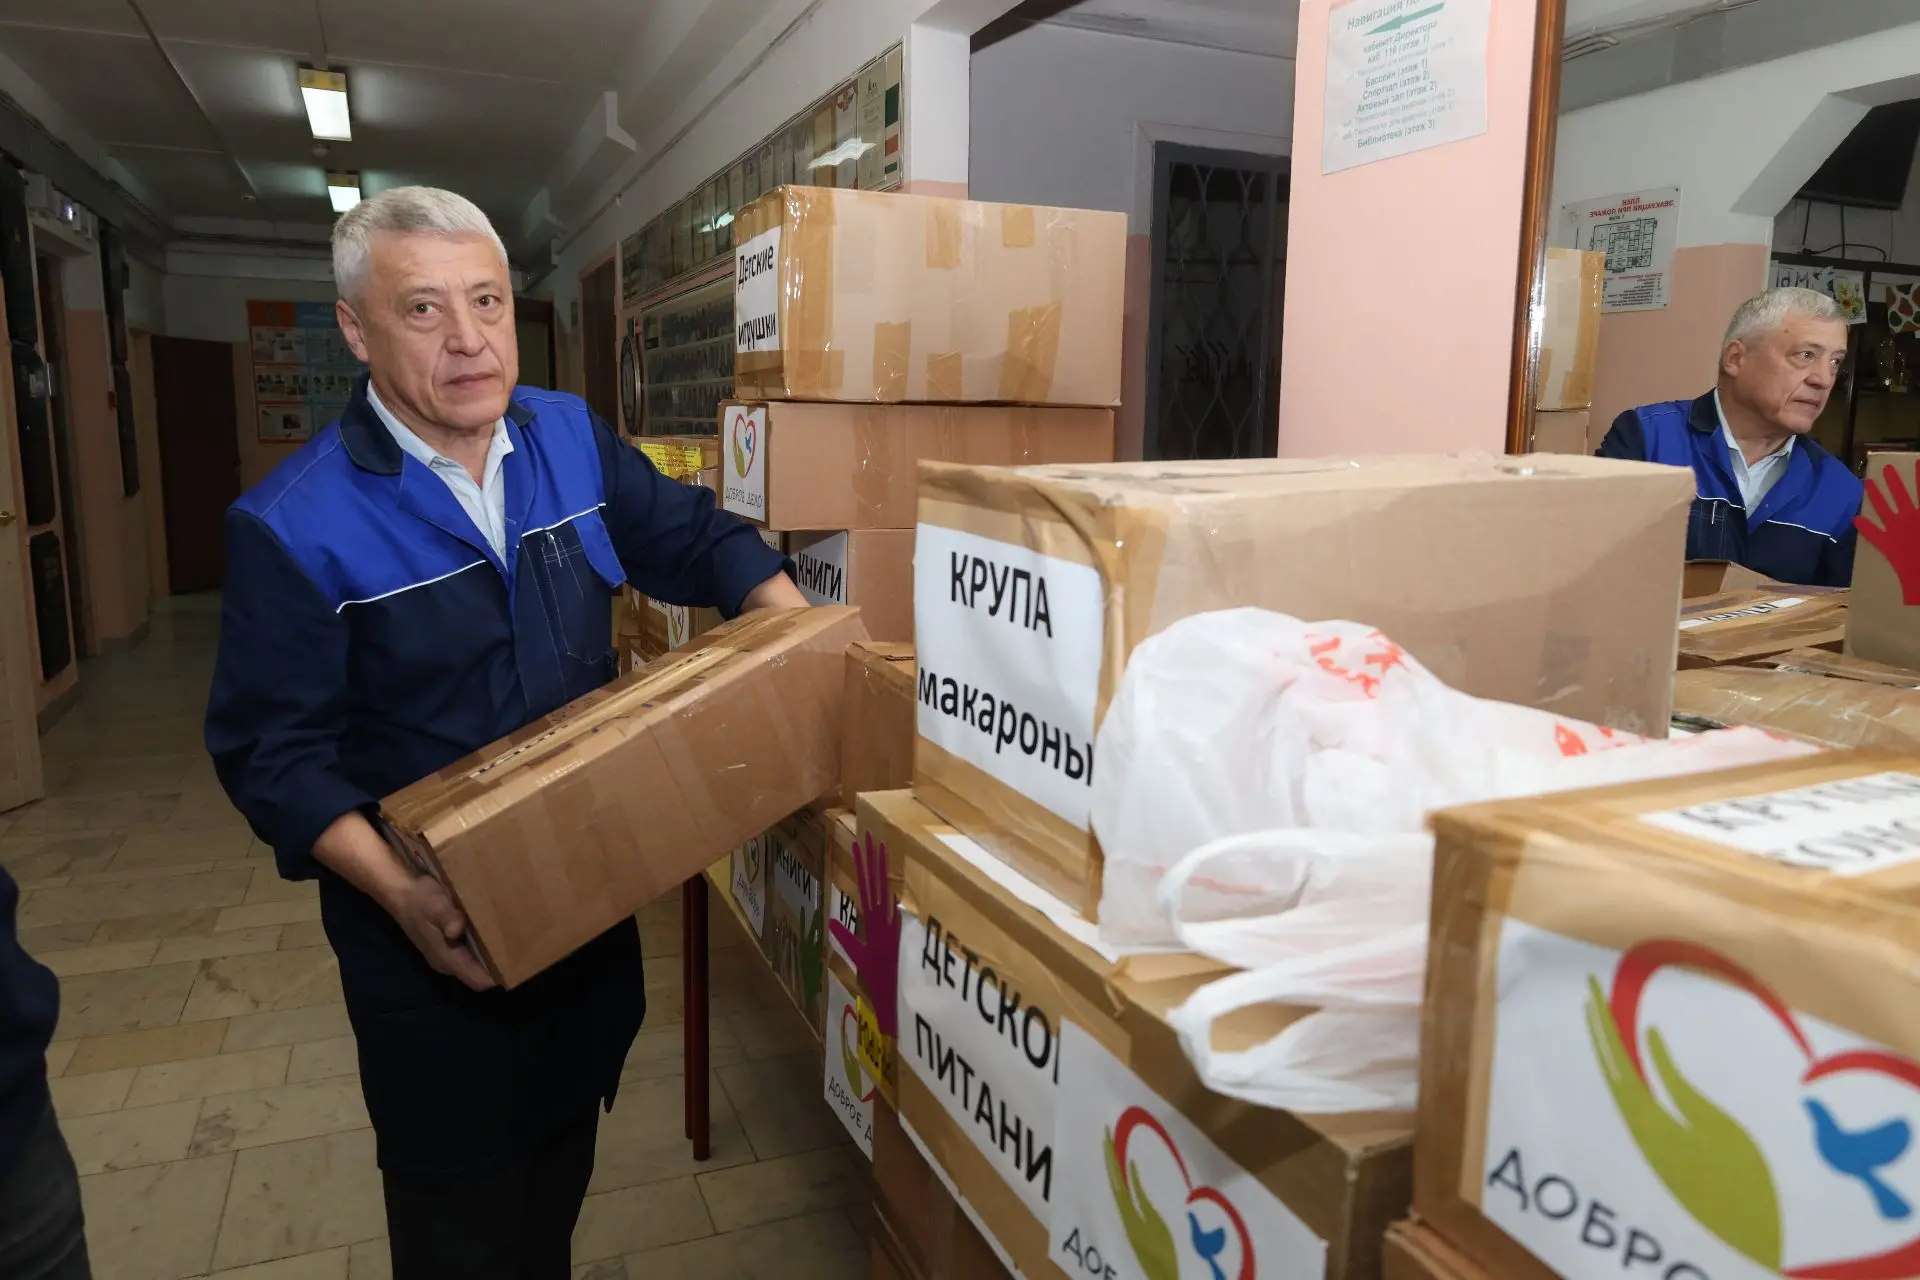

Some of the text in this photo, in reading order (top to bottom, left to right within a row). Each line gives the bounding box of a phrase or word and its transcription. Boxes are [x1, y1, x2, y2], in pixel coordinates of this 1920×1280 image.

[1394, 20, 1438, 44] Директора
[1356, 98, 1389, 113] Актовый
[1362, 82, 1398, 100] Спортзал
[1357, 130, 1403, 149] Библиотека
[738, 245, 774, 292] Детские
[738, 313, 776, 350] игрушки
[798, 552, 841, 601] КНИГИ
[950, 551, 1052, 638] КРУПА
[918, 666, 1093, 787] макароны
[776, 839, 811, 902] КНИГИ
[828, 1075, 863, 1129] ДОБРОЕ
